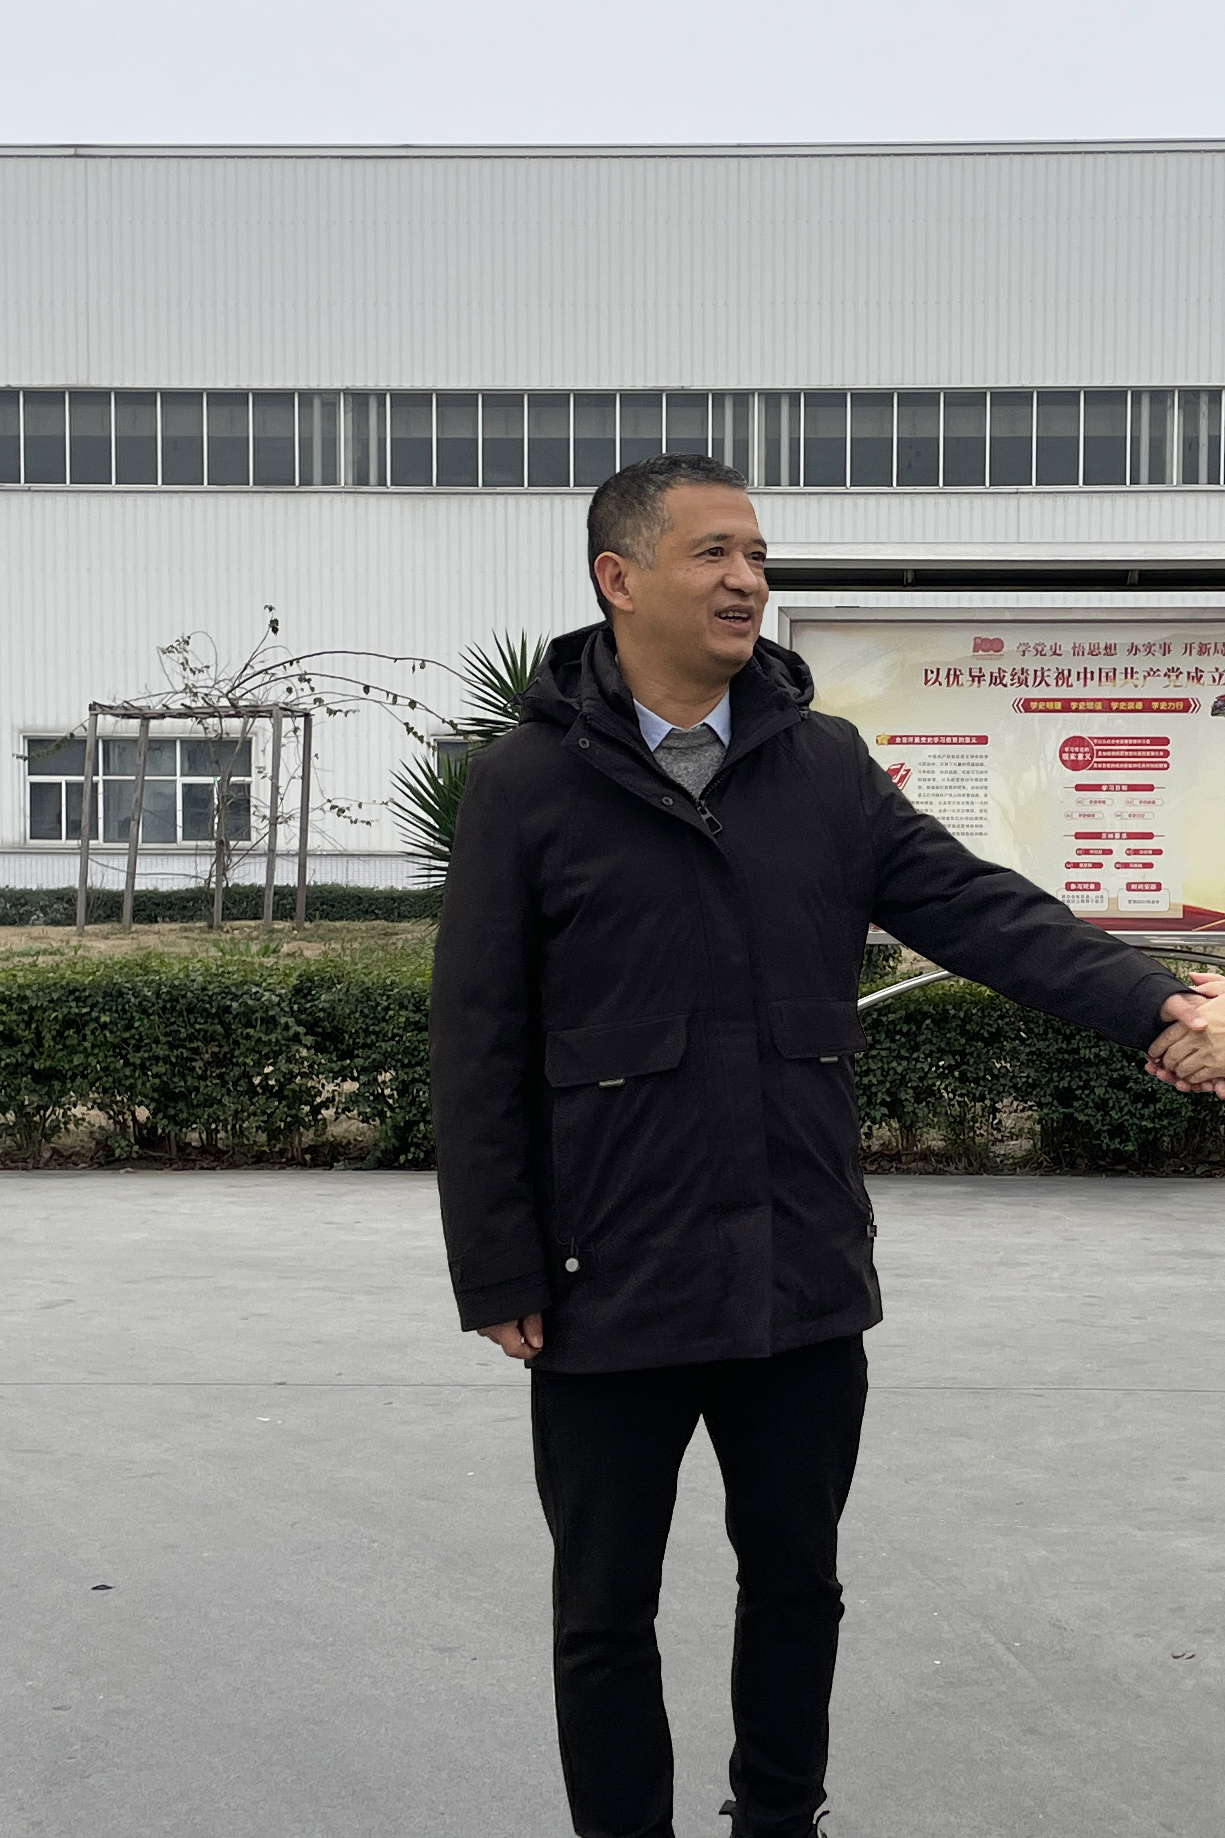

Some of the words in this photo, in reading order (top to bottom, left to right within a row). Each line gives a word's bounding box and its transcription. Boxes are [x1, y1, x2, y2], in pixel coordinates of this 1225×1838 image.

[1016, 641, 1063, 657] 学党史
[1071, 641, 1118, 657] 悟思想
[1126, 641, 1172, 657] 办实事
